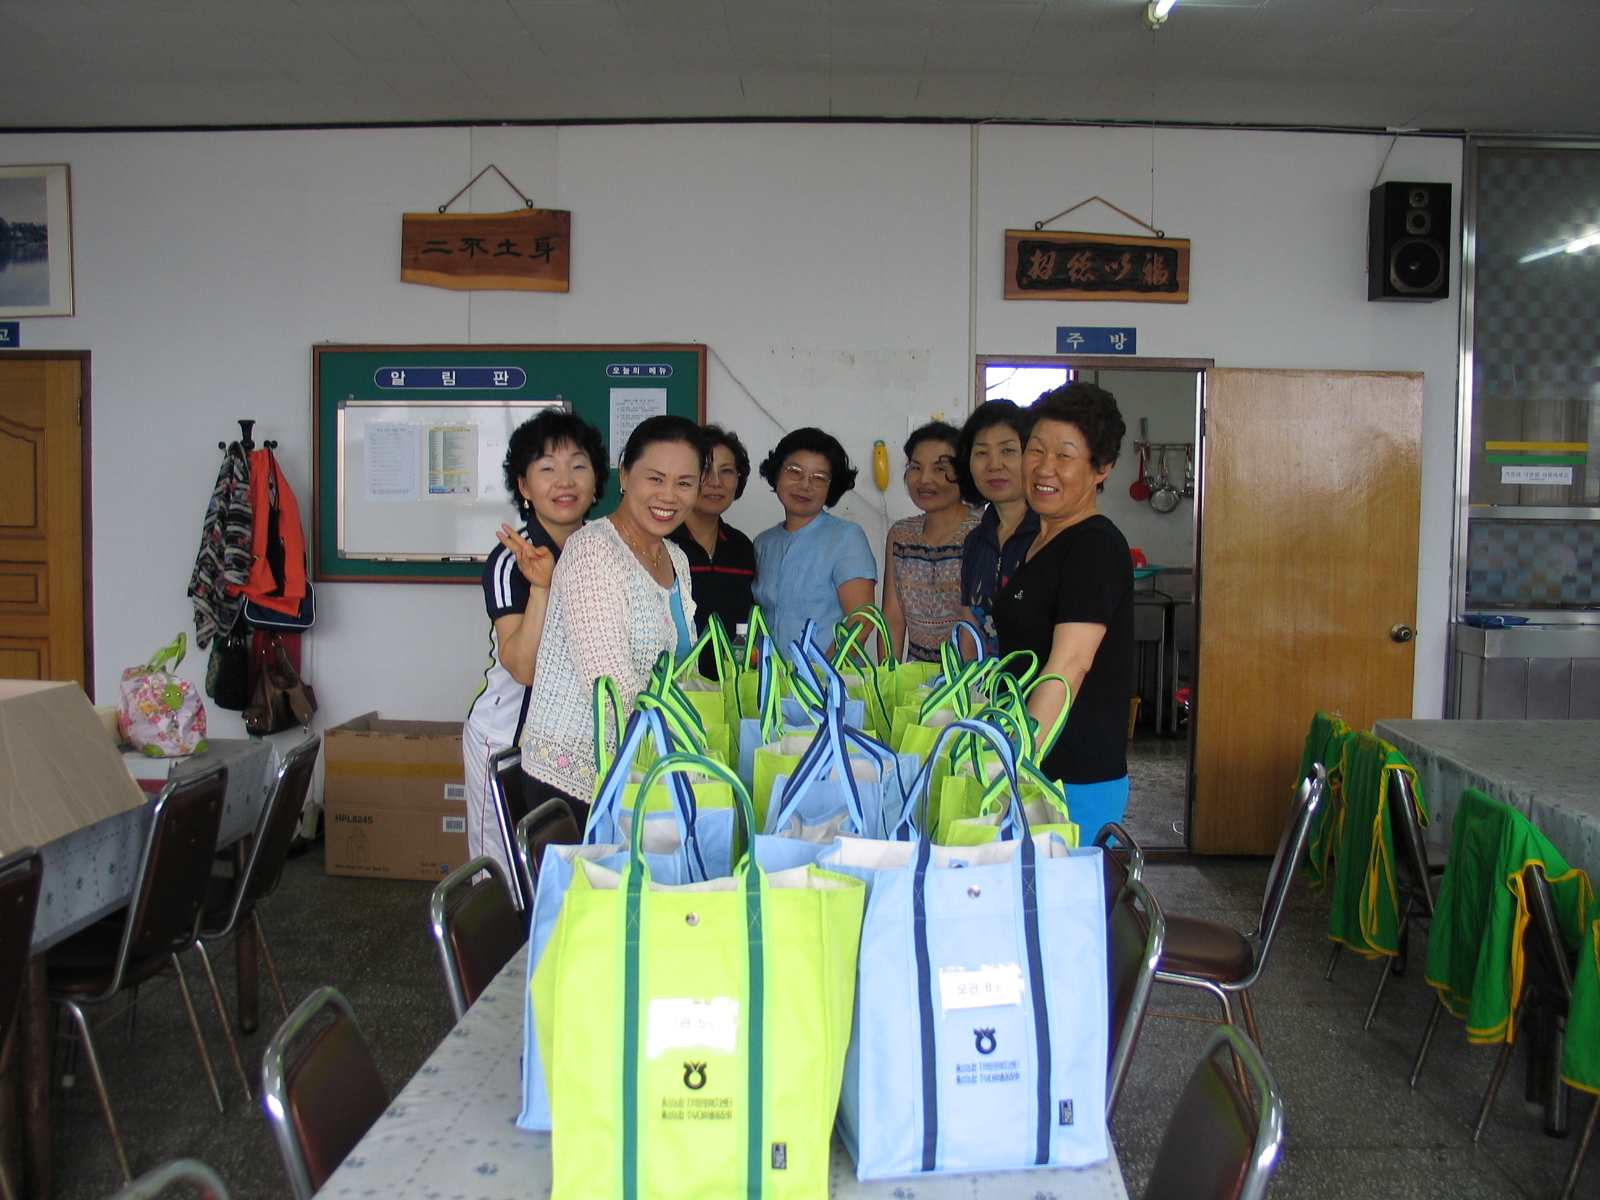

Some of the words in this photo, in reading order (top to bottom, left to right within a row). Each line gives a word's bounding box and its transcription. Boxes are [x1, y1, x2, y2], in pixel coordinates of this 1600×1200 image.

[612, 366, 640, 375] 오늘의
[648, 366, 667, 375] 메뉴
[335, 814, 374, 825] HPL824S
[671, 1016, 691, 1029] 관
